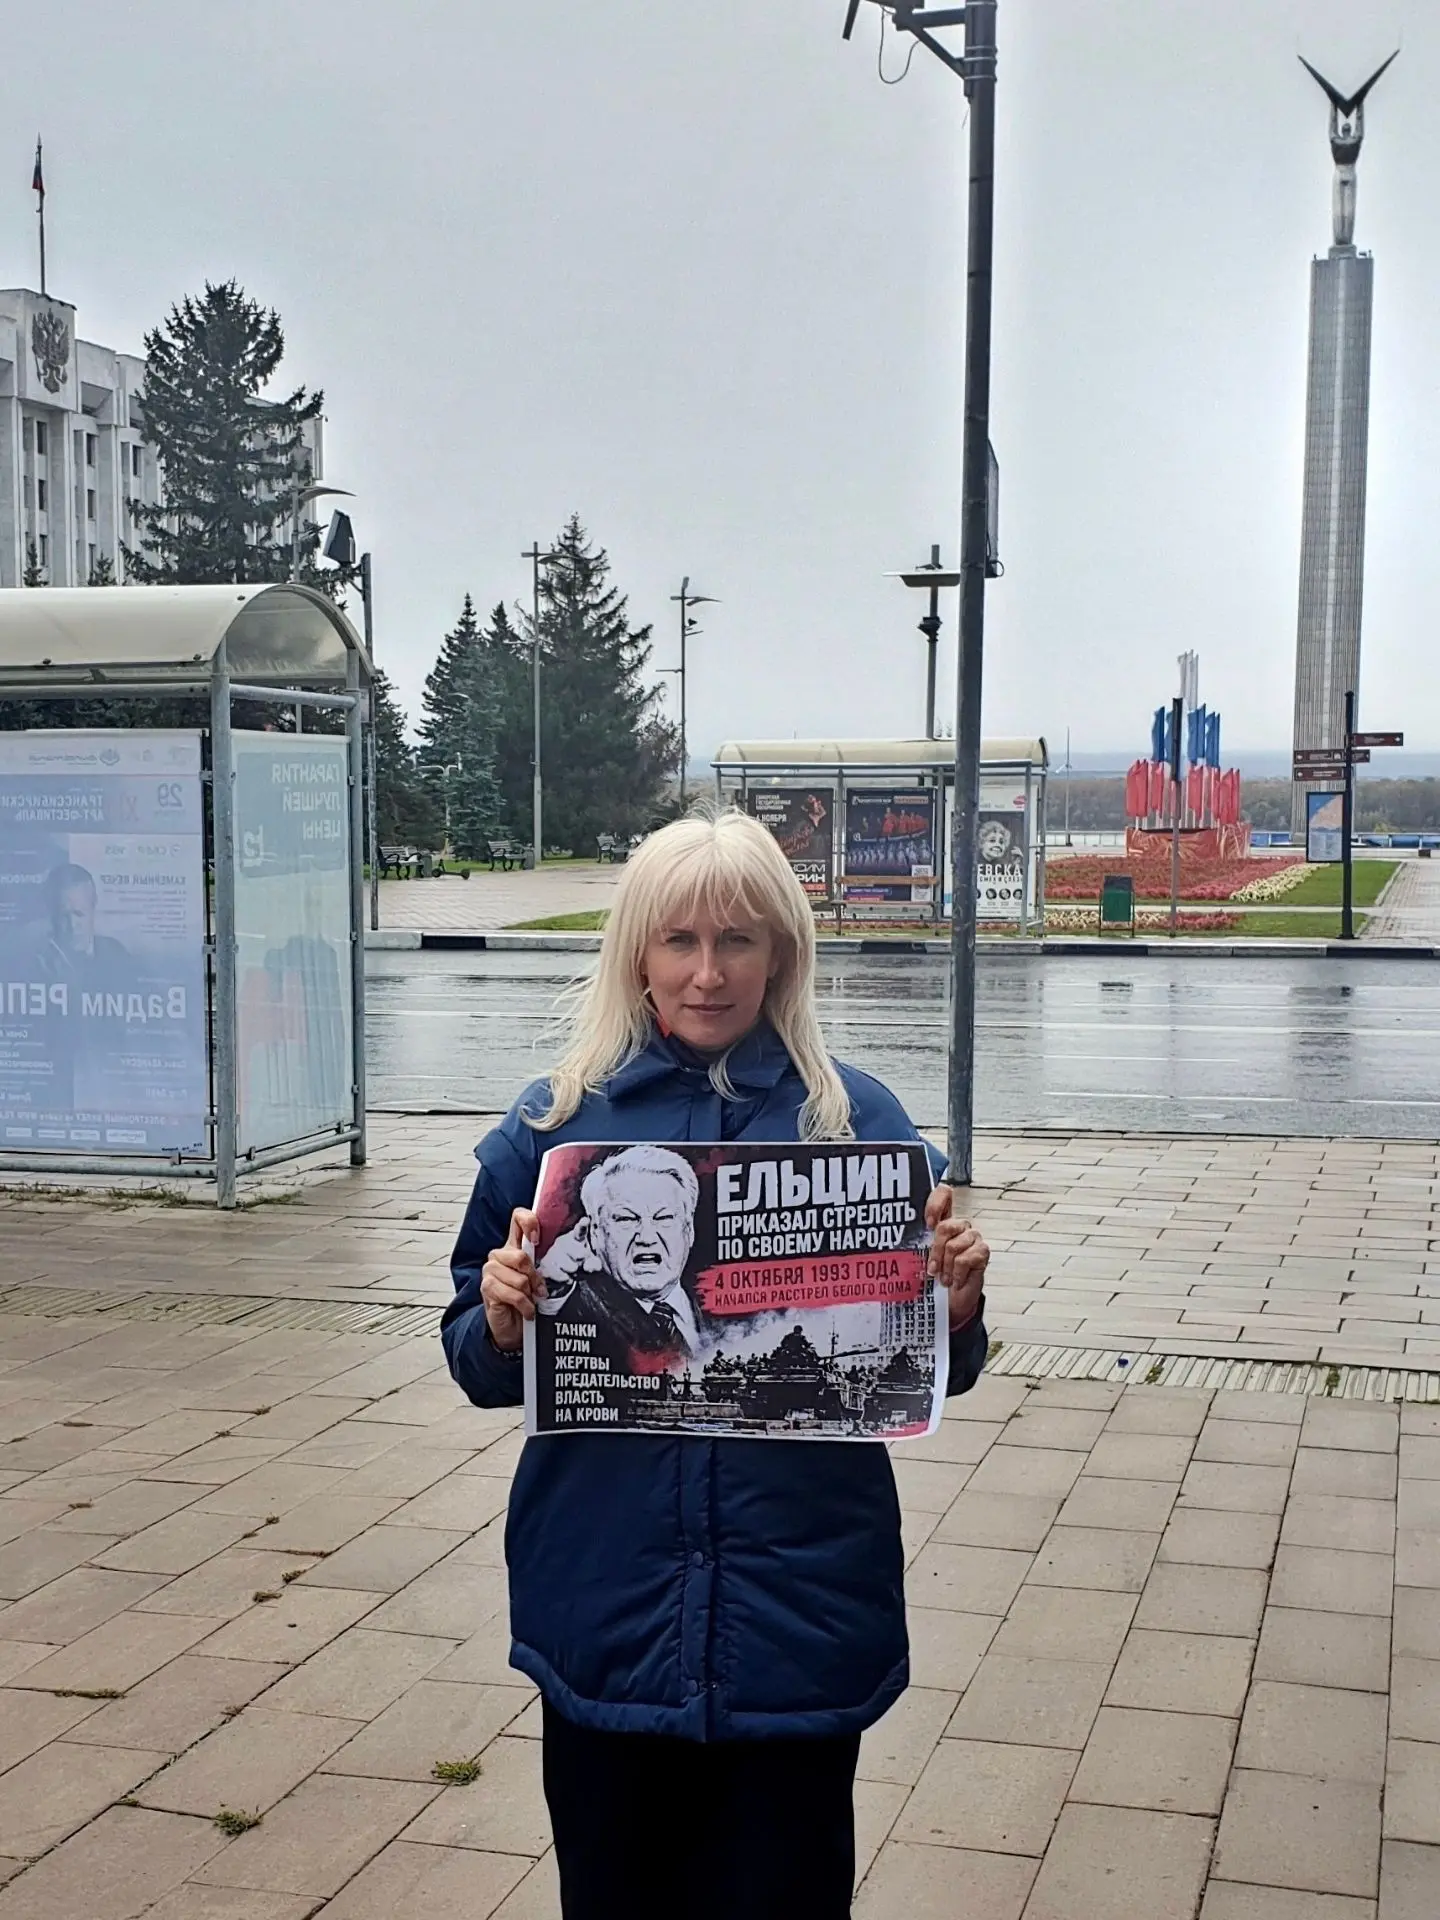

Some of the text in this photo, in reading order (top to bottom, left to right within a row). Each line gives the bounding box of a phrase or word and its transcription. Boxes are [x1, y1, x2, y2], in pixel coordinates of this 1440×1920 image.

[793, 863, 826, 872] СИМ
[977, 863, 1023, 876] ЕВСКА
[796, 873, 826, 883] РИН
[717, 1152, 910, 1214] ЕЛЬЦИН
[717, 1202, 915, 1237] ПРИКАЗАЛ СТРЕЛЯТЬ
[717, 1224, 905, 1260] ПО СВОЕМУ НАРОДУ
[715, 1260, 900, 1289] 4 ОКТЯБРЯ 1993 ГОДА
[715, 1281, 912, 1307] НАЧАЛСЯ РАССТРЕЛ БЕЛОГО ДОМА
[555, 1322, 597, 1338] ТАНКИ
[555, 1339, 590, 1353] ПУЛИ
[555, 1355, 609, 1370] ЖЕРТВЫ
[555, 1373, 660, 1389] ПРЕДАТЕЛЬСТВО
[555, 1390, 604, 1405] ВЛАСТЬ
[555, 1408, 618, 1422] НА КРОВИ
